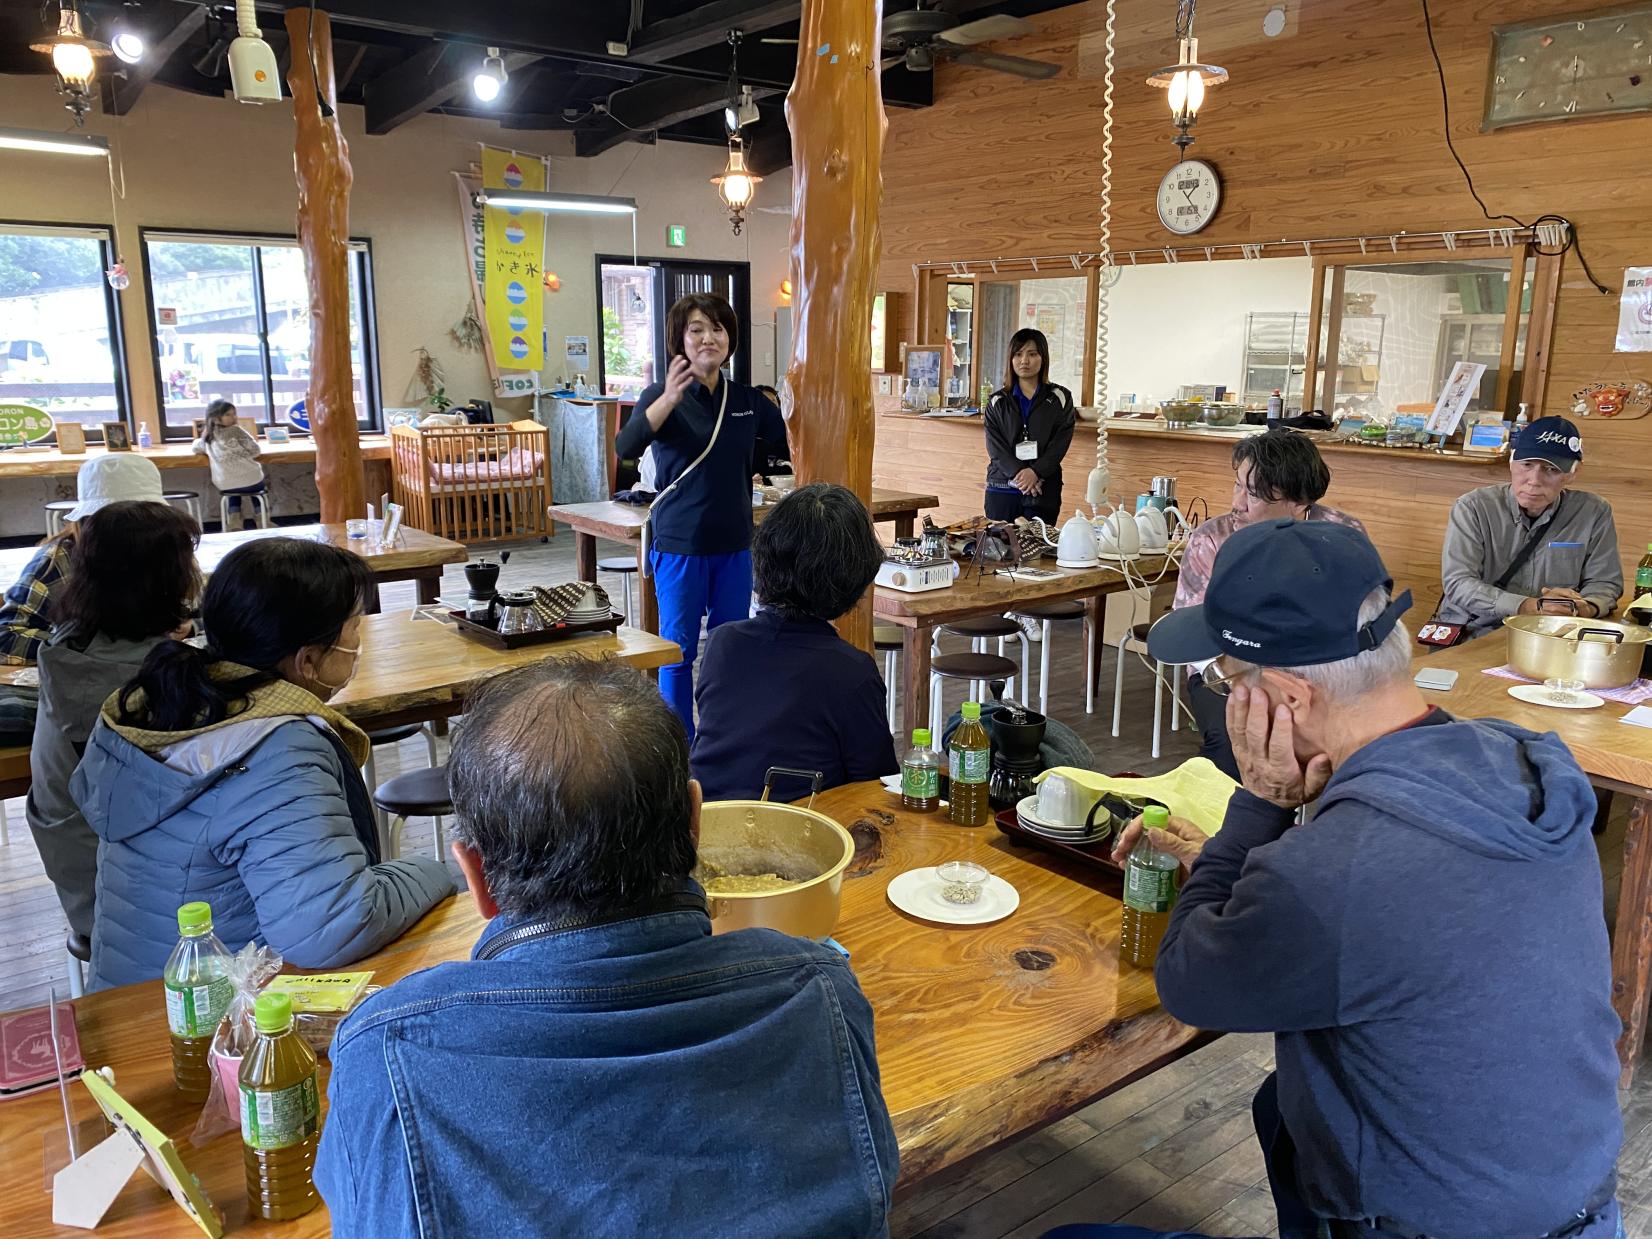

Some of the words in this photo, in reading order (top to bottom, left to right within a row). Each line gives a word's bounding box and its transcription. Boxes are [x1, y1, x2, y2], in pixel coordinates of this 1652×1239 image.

[496, 260, 540, 278] かき氷
[1536, 431, 1567, 445] JAXA
